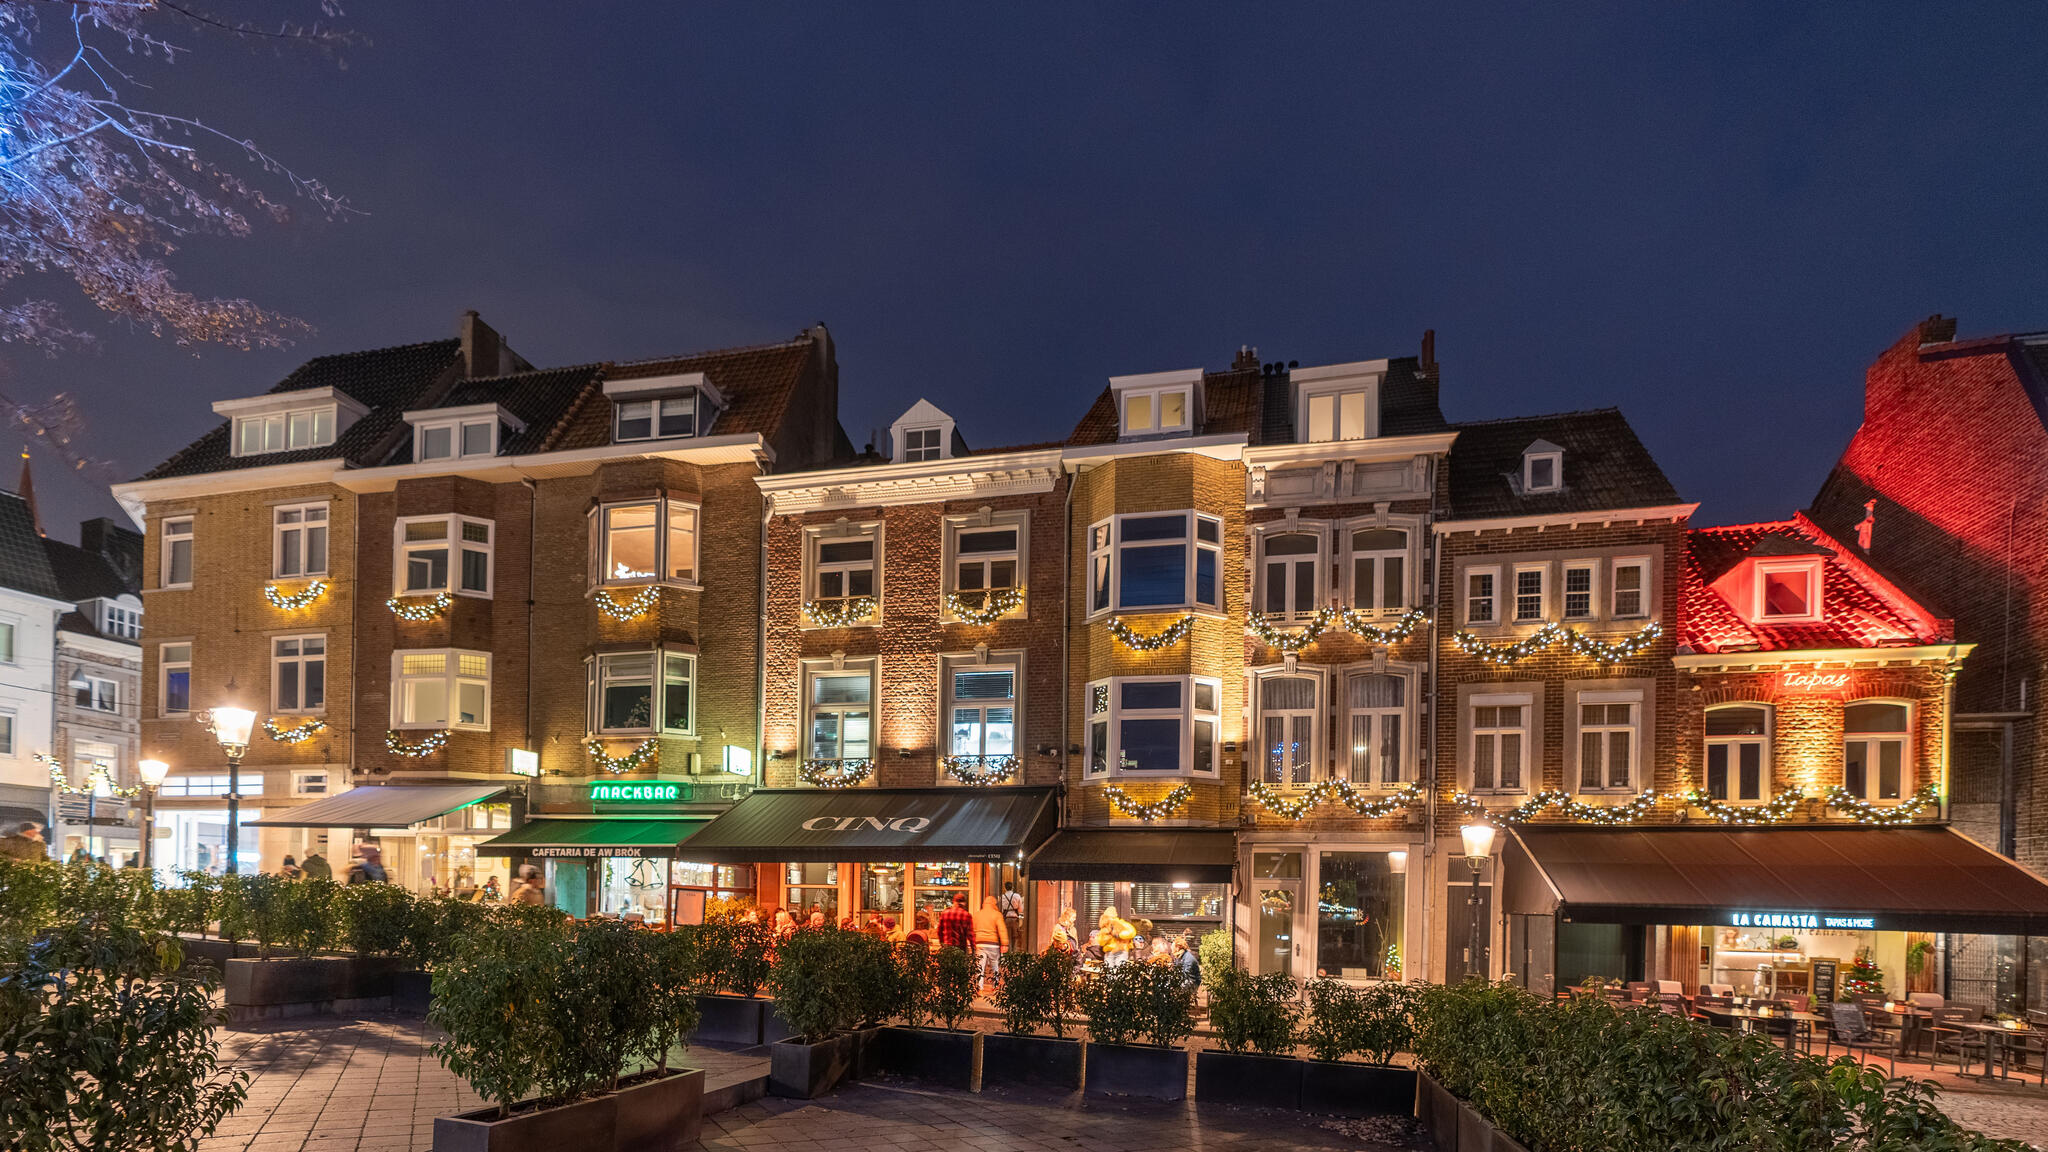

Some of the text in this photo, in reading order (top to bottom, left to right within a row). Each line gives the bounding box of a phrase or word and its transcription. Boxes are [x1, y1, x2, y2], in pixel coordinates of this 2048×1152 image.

[1784, 671, 1851, 691] Tapas
[590, 786, 679, 800] SNACKBAR
[801, 816, 930, 832] CINQ
[532, 847, 581, 857] CAFETARIA
[583, 847, 596, 857] DE
[598, 847, 613, 857] AW
[1732, 913, 1750, 926] LA
[1753, 914, 1819, 928] CANASTA
